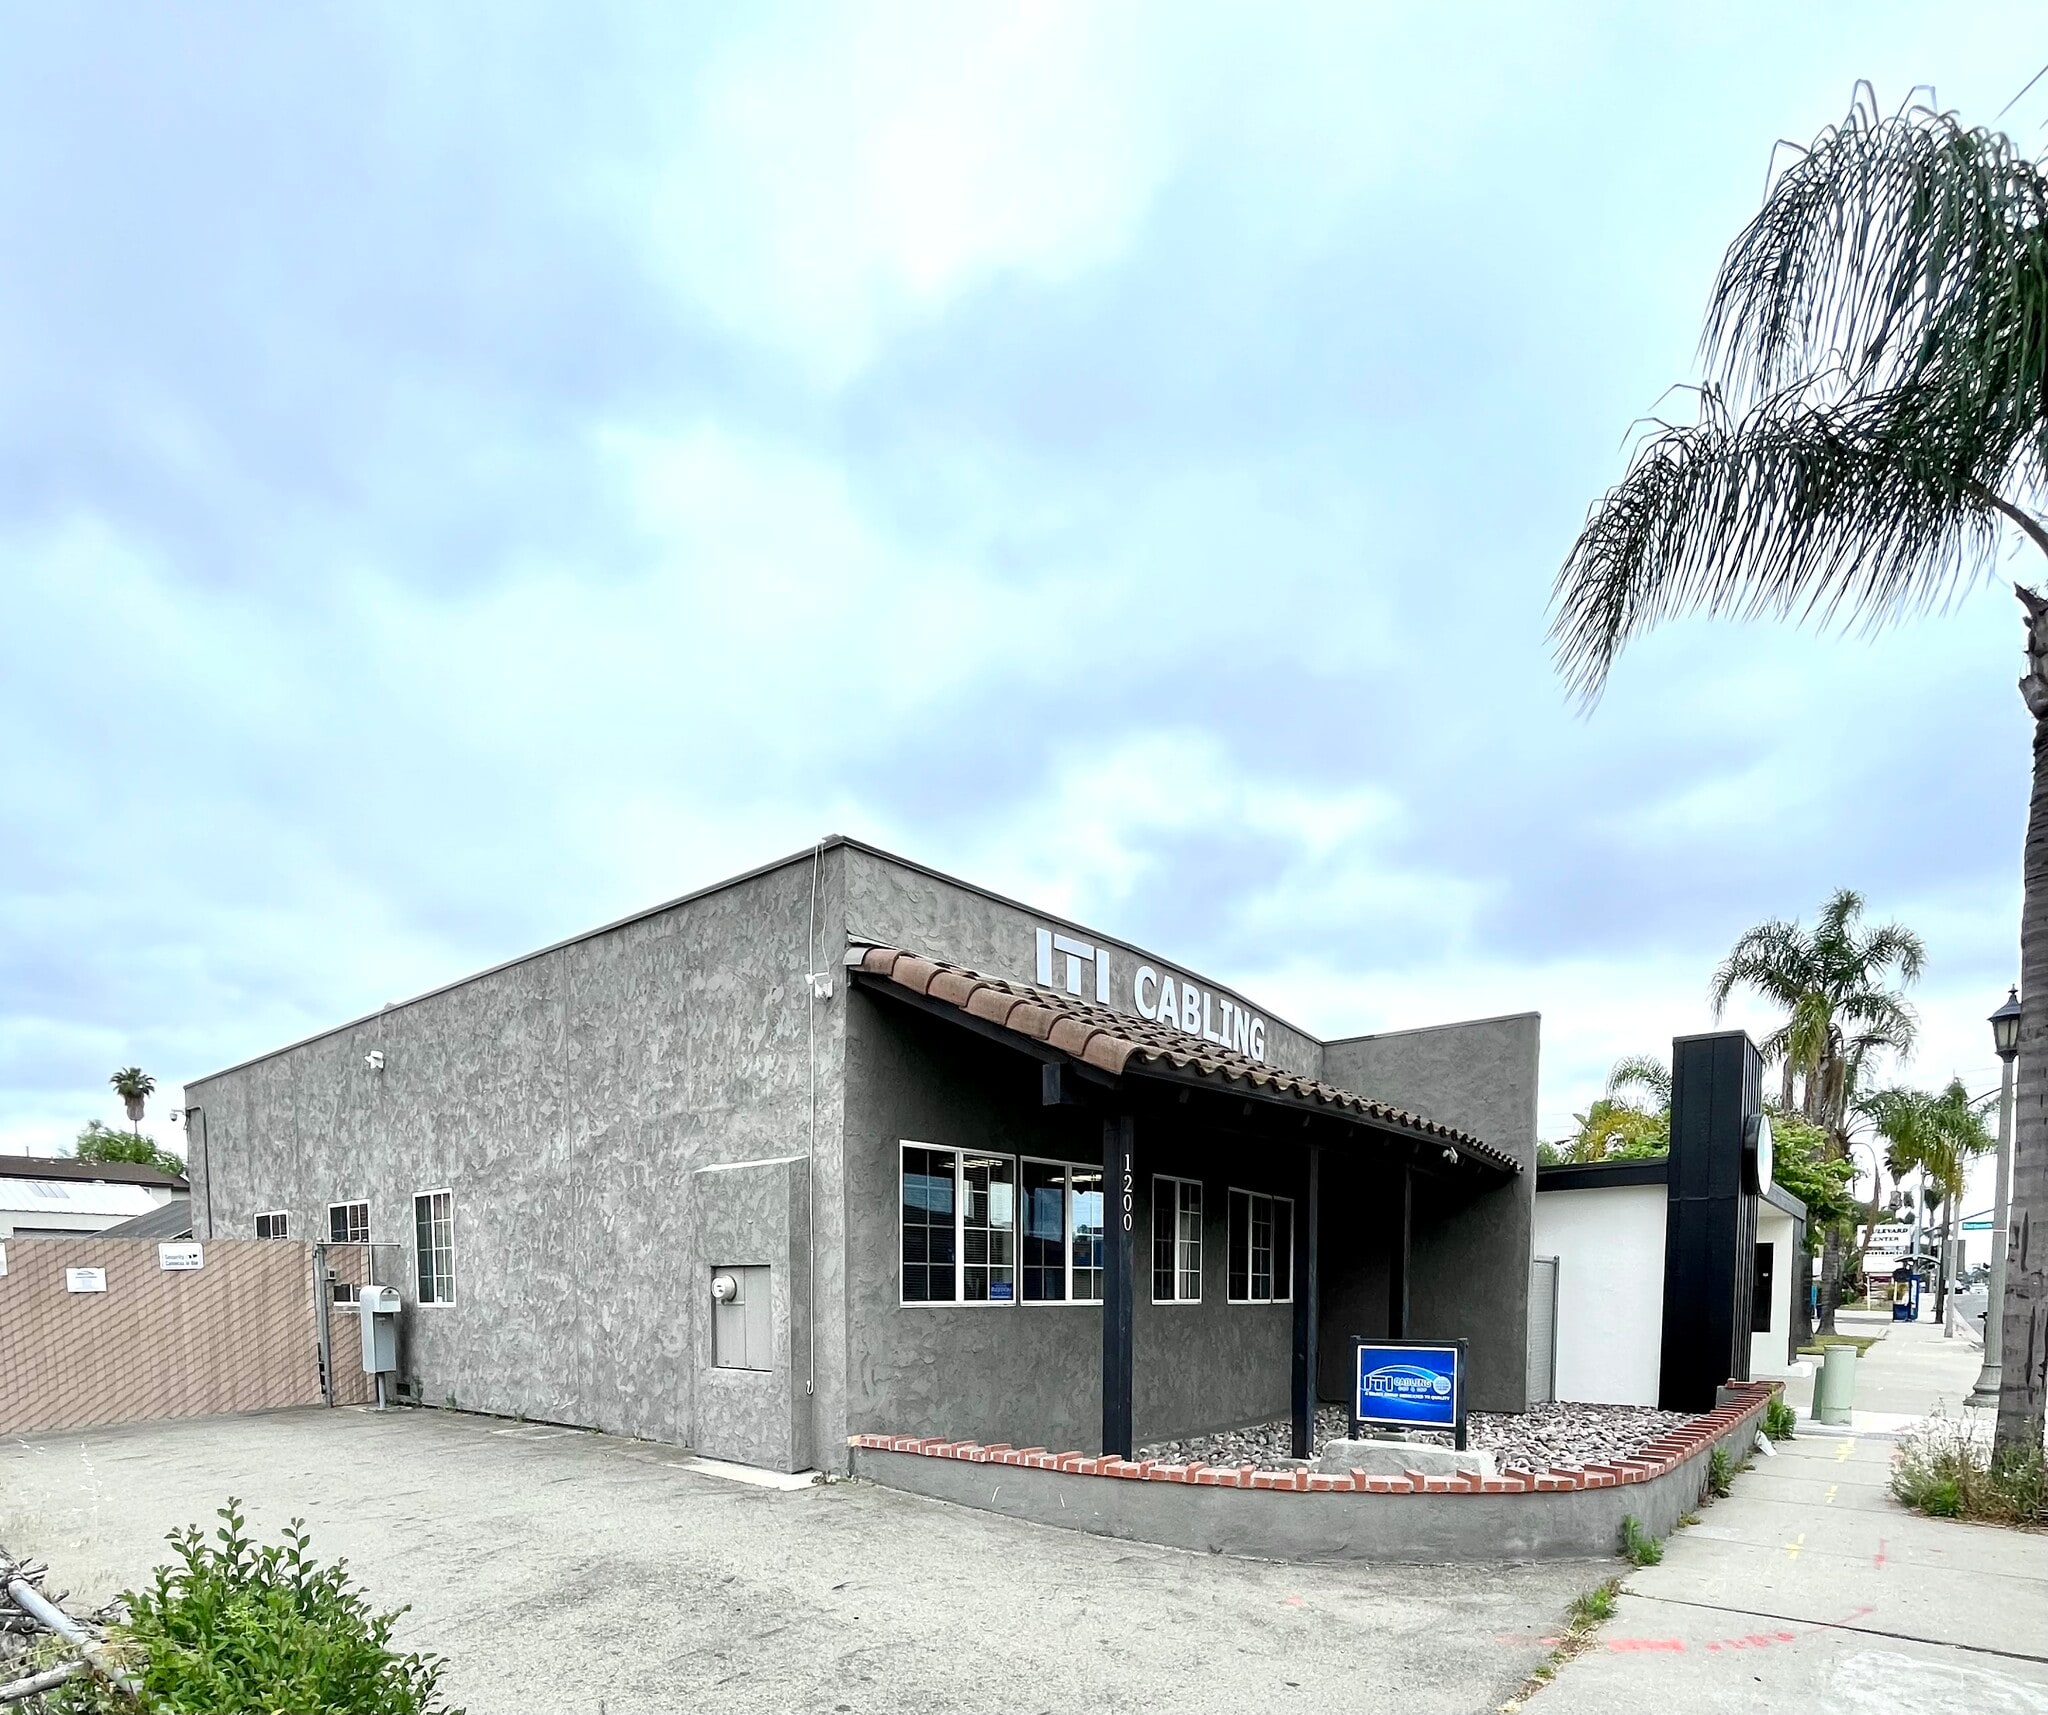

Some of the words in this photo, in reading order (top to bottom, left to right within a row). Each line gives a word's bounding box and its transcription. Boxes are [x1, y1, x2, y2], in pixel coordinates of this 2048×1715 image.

[1036, 927, 1110, 1005] ITI
[1133, 965, 1265, 1062] CABLING
[1123, 1153, 1132, 1231] 1200
[1364, 1374, 1393, 1392] ITI
[1394, 1377, 1431, 1388] CABLING
